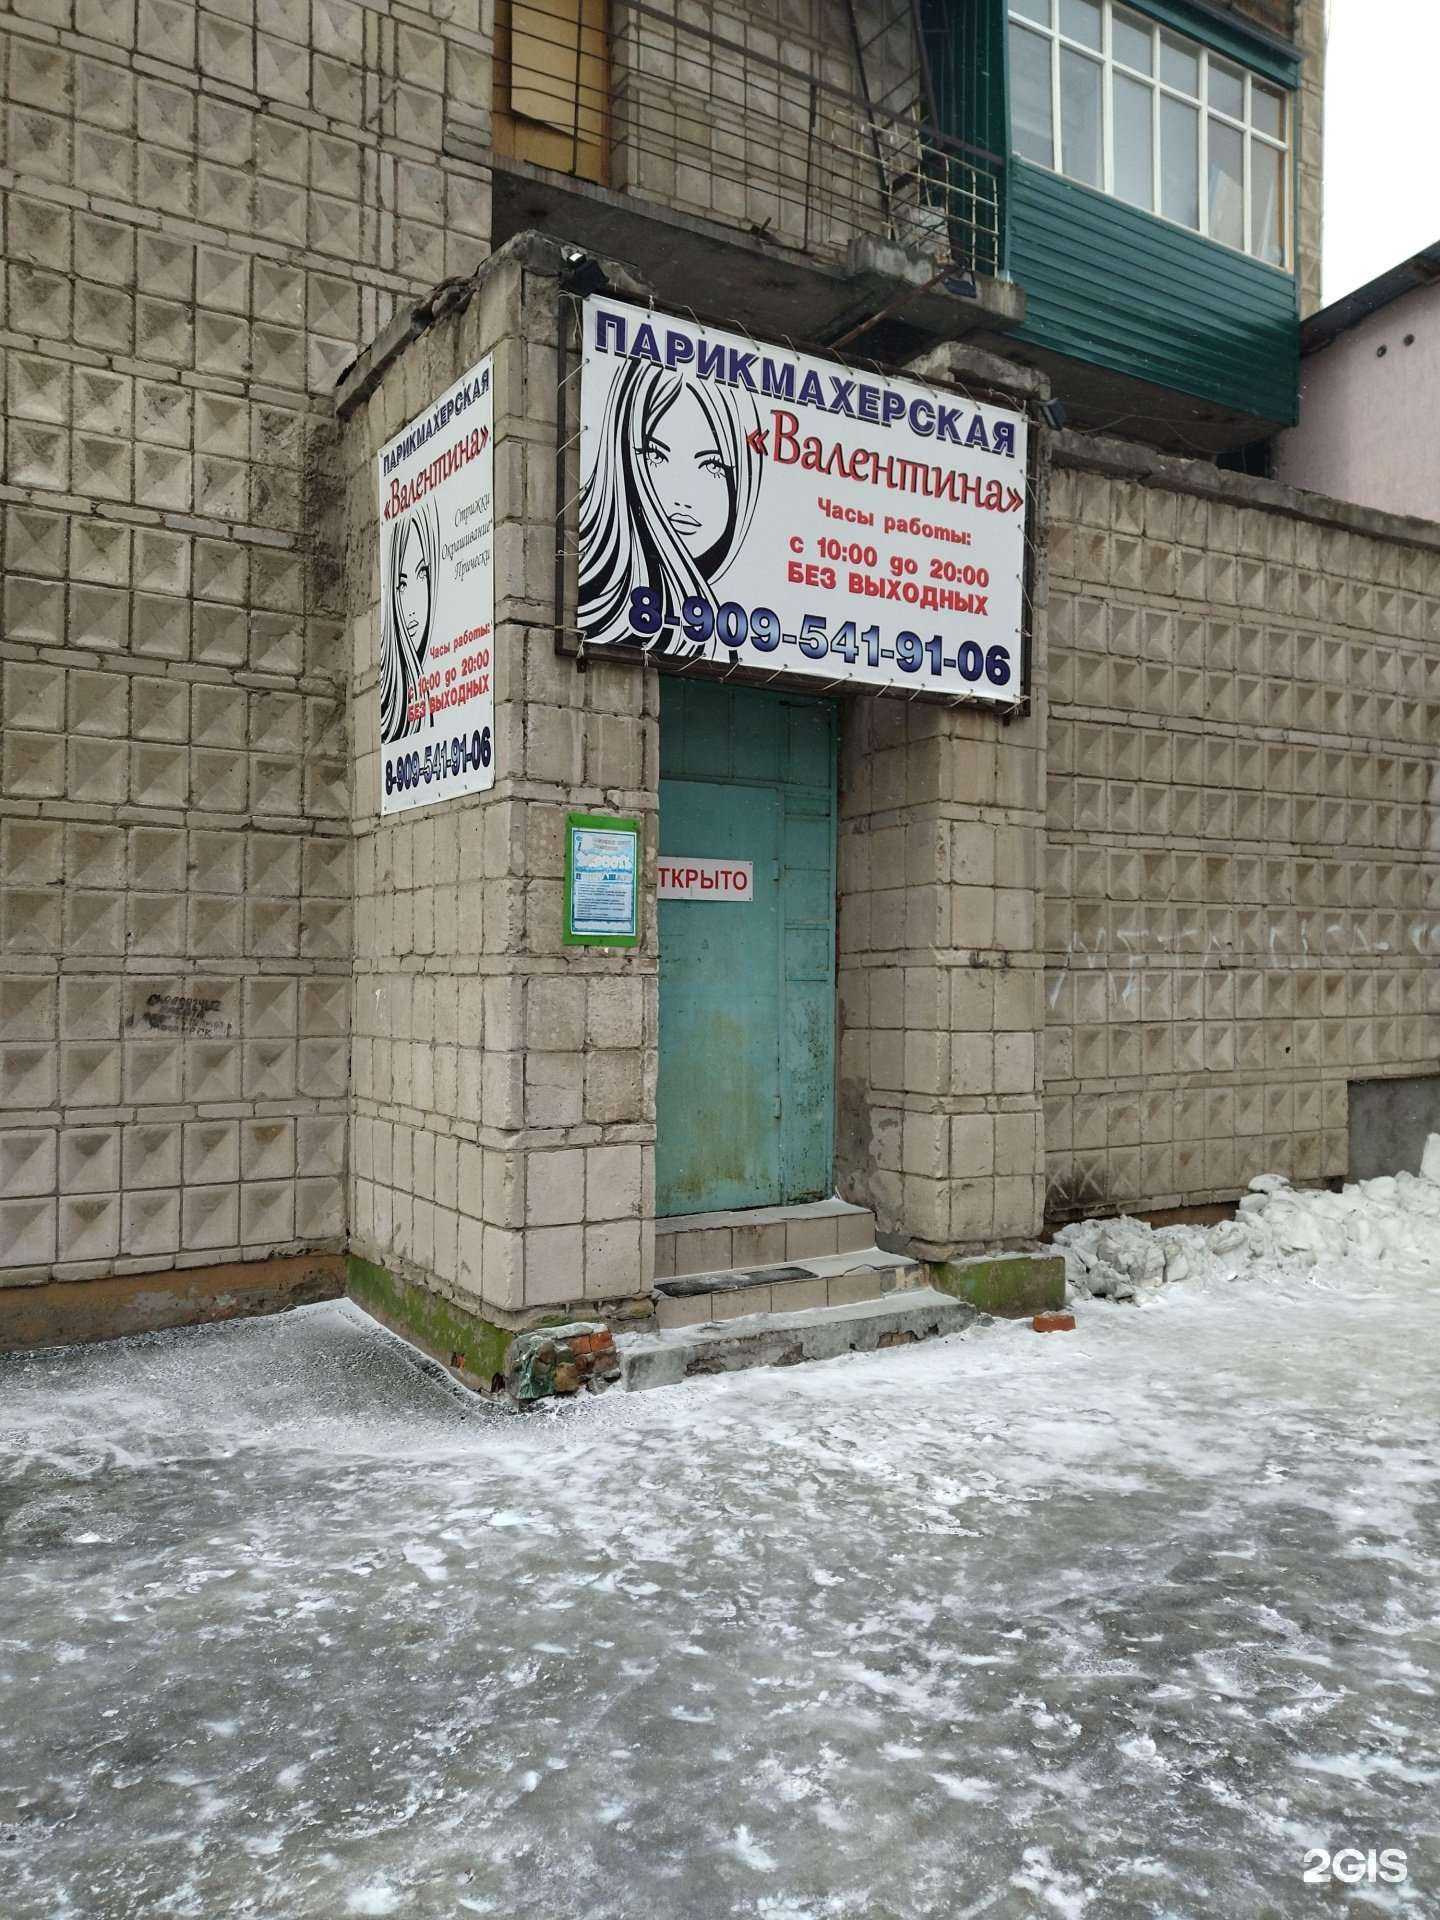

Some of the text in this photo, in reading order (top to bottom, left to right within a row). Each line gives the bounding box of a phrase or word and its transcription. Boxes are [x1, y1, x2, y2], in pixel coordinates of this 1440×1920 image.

[594, 309, 1016, 459] ПАРИКМАХЕРСКАЯ
[383, 367, 490, 477] ПАРИКМАХЕРСКАЯ
[383, 424, 490, 522] «Валентина»
[745, 409, 1024, 514] «Валентина»
[454, 493, 490, 528] Стрижки
[817, 497, 972, 546] Часы работы:
[787, 560, 989, 617] БЕЗ ВЫХОДНЫХ
[816, 538, 878, 568] 10:00
[889, 551, 918, 578] до
[929, 558, 990, 589] 20:00
[429, 622, 491, 660] Часы работы:
[628, 586, 1012, 687] 8-909-541-91-06
[407, 674, 490, 724] БЕЗ ВЫХОДНЫХ
[418, 672, 441, 698] 10:00
[445, 667, 457, 688] до
[461, 649, 490, 677] 20:00
[385, 726, 491, 796] 8-909-541-91-06
[657, 867, 748, 891] ТКРЫТО
